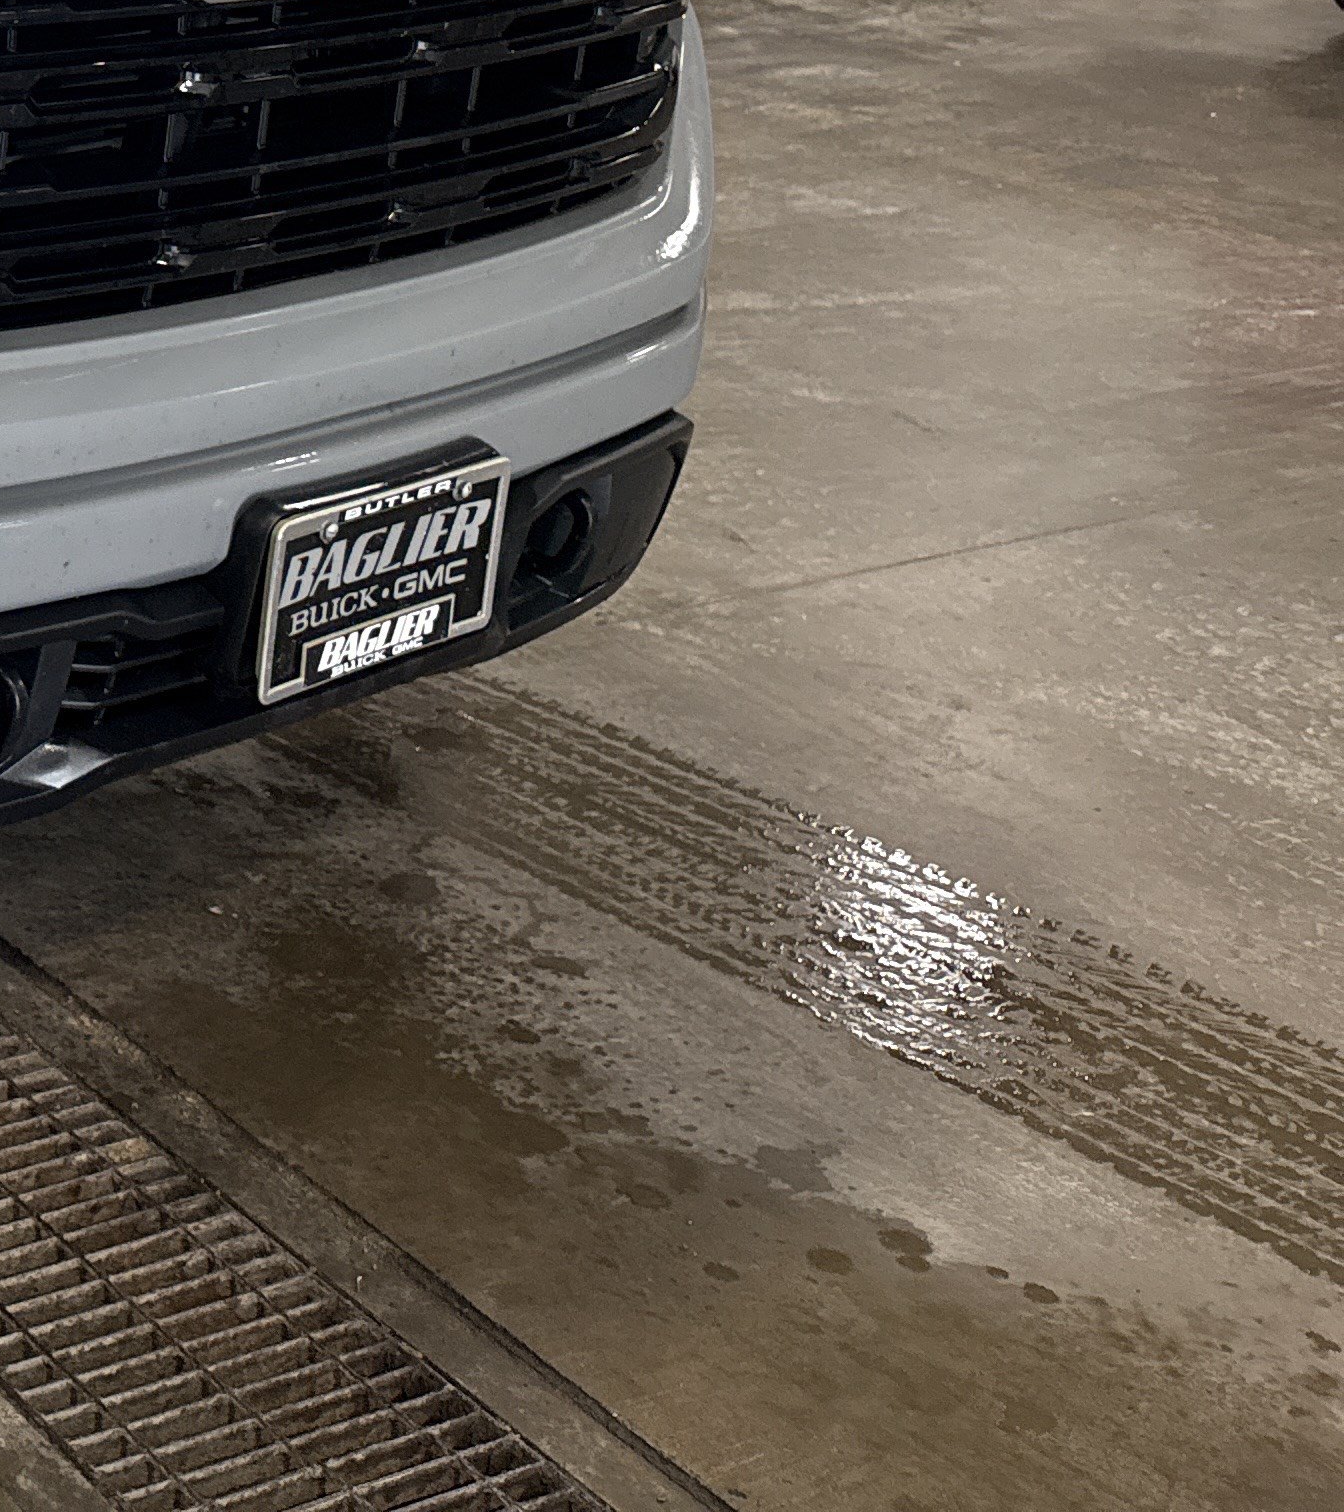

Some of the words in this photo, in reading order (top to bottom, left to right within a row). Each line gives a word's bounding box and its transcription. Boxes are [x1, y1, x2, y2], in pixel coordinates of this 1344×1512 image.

[344, 479, 452, 521] BUTLER
[277, 497, 492, 610] BAGLIER
[288, 584, 380, 637] BUICK
[393, 557, 468, 600] GMC
[317, 604, 440, 673] BAGLIER
[330, 648, 387, 678] BUICK
